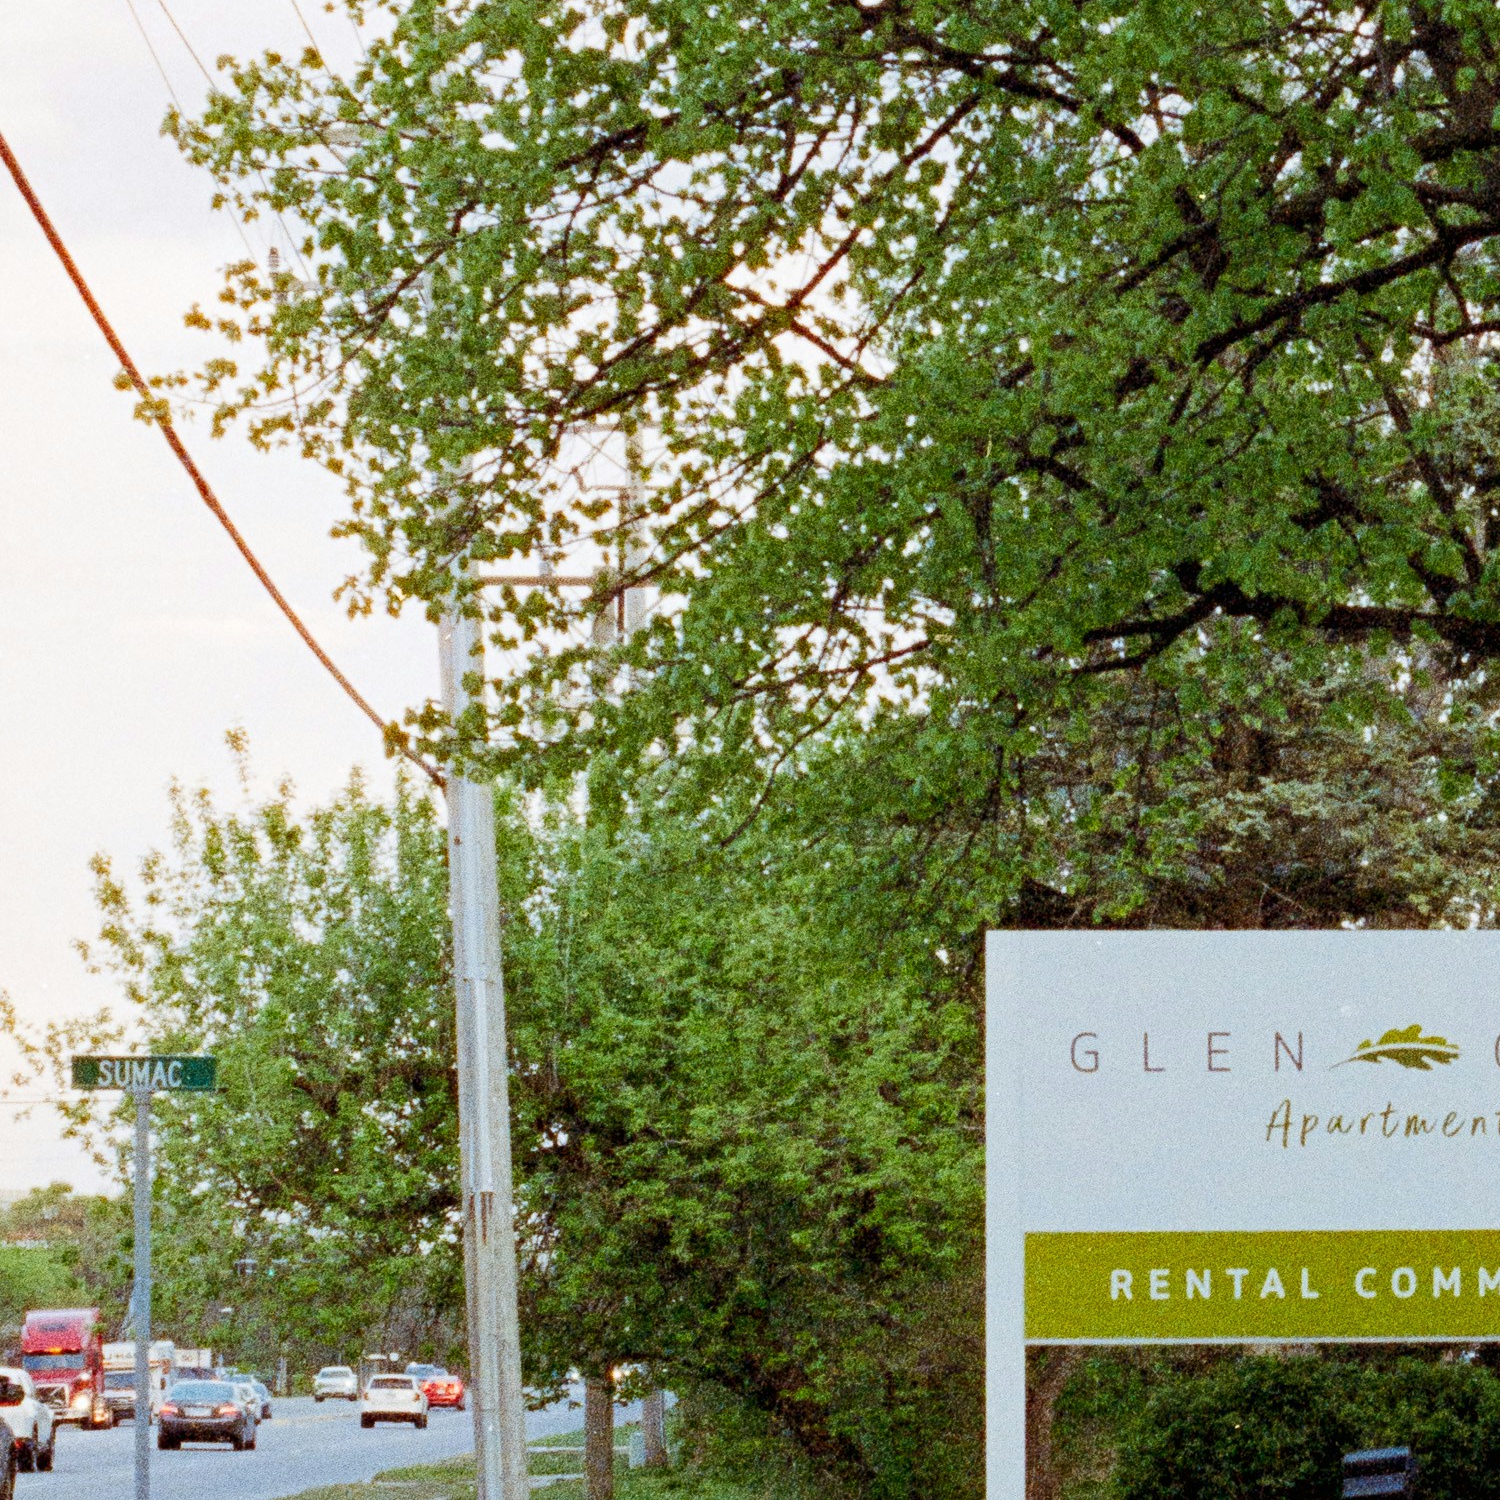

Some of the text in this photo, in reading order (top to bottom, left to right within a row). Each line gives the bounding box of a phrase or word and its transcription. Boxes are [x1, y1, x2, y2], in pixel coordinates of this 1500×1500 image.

[1070, 1032, 1305, 1074] GLEN
[98, 1059, 183, 1087] SUMAC
[1110, 1268, 1321, 1302] RENTAL
